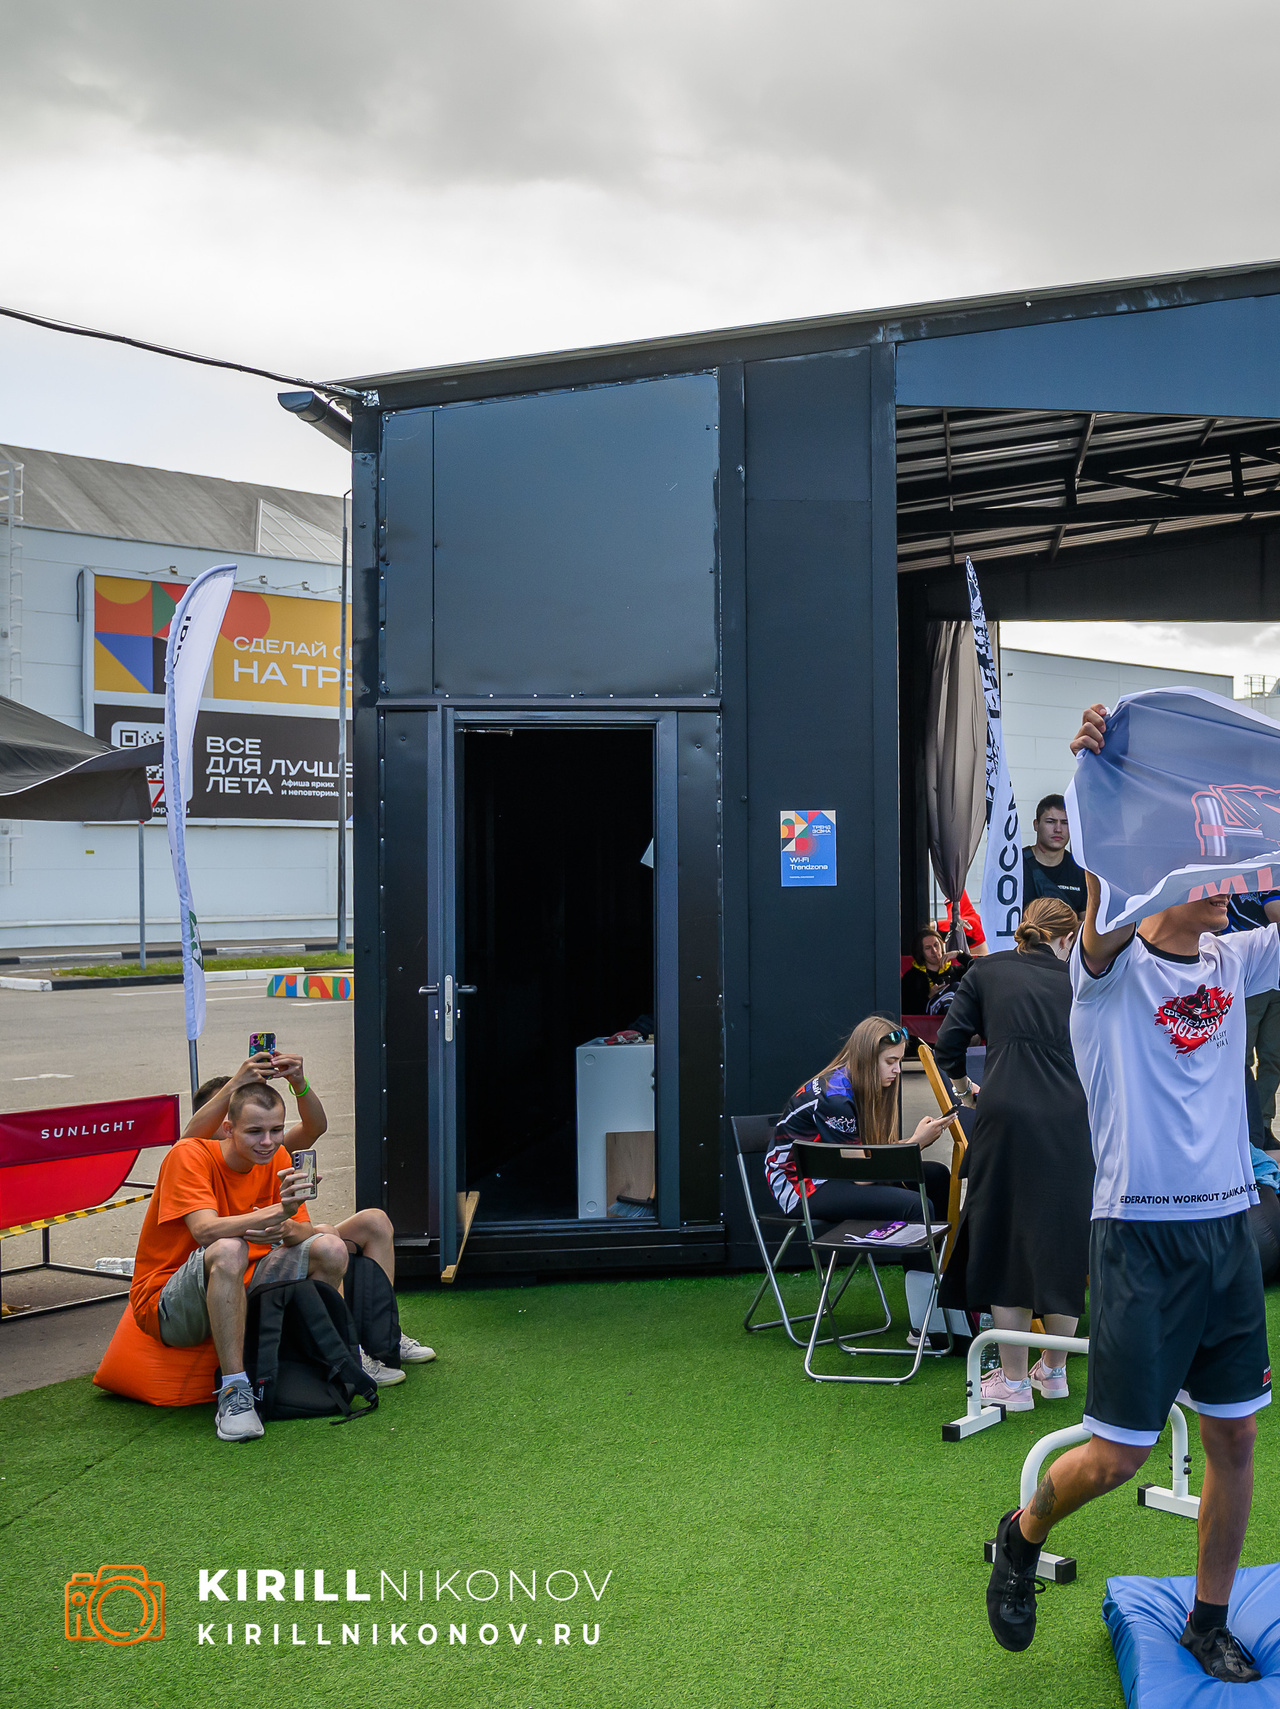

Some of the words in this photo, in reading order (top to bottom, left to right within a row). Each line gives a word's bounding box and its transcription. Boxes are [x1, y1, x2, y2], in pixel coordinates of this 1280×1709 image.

[233, 636, 327, 658] СДЕЛАЙ
[233, 659, 288, 686] НА
[206, 736, 262, 755] ВСЕ
[205, 756, 262, 775] ДЛЯ
[205, 777, 274, 794] ЛЕТА
[281, 779, 310, 788] Афиша
[311, 781, 335, 789] ярких
[41, 1120, 135, 1139] SUNLIGHT
[1172, 1192, 1220, 1205] WORKOUT
